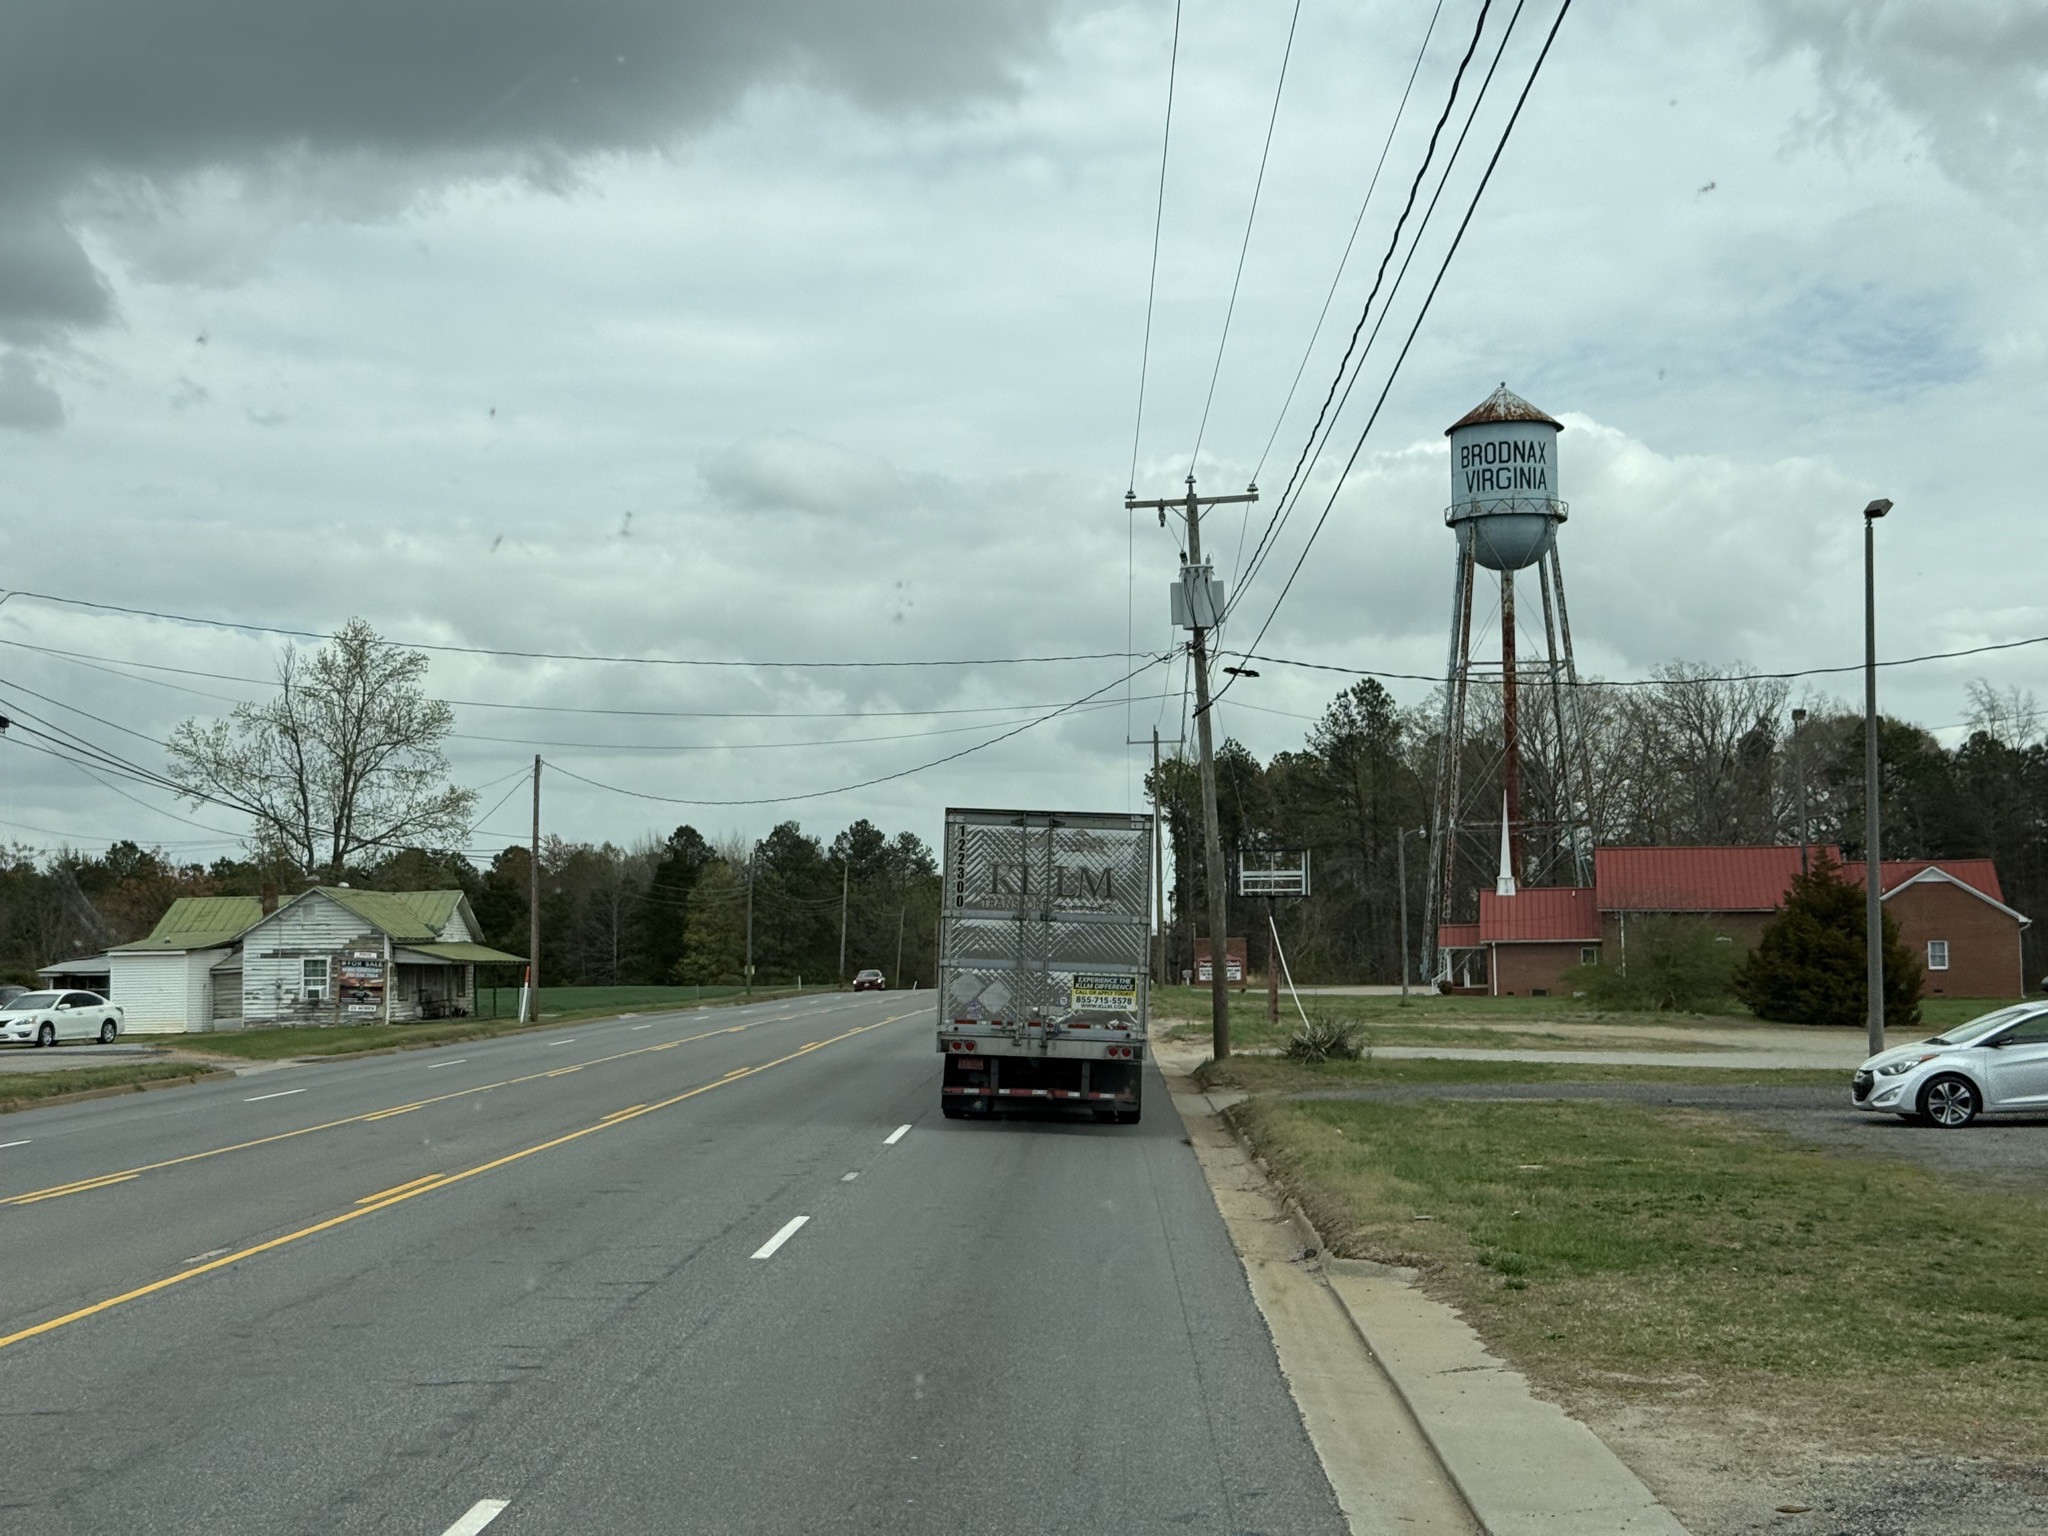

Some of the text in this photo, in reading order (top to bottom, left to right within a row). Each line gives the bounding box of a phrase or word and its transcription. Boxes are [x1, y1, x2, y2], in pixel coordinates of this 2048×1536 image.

[1461, 440, 1546, 469] BRODNAX
[1466, 466, 1547, 493] VIRGINIA
[957, 825, 966, 907] 122300
[981, 899, 1048, 911] TRANSPORT
[1076, 996, 1132, 1005] 855-715-5578
